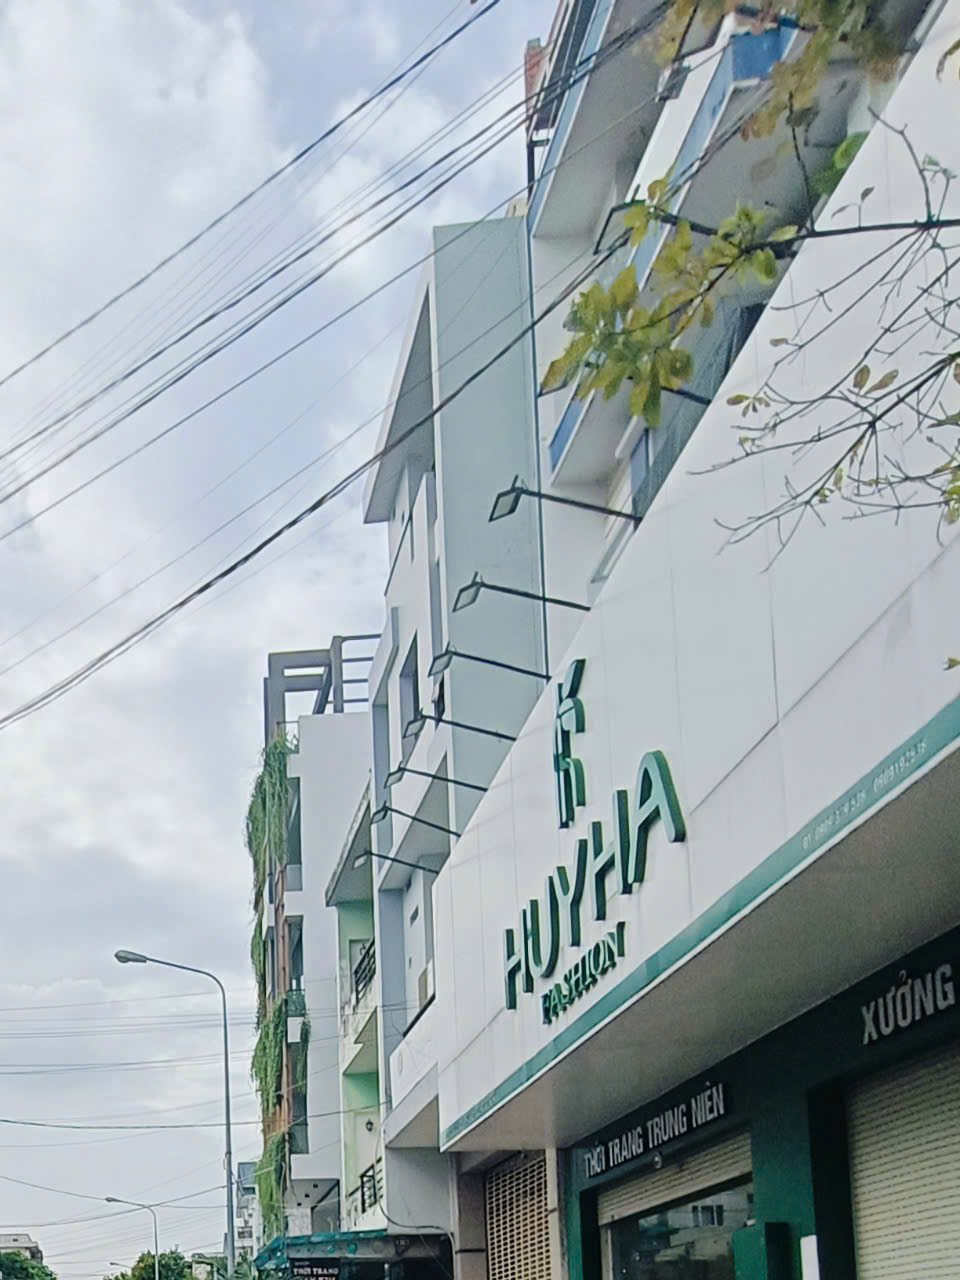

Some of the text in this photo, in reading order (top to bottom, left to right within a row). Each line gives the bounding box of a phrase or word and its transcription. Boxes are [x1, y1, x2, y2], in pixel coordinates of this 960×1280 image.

[504, 749, 686, 1010] HUYHA
[541, 921, 626, 1025] FASHION
[861, 963, 956, 1045] XƯỞNG
[607, 1125, 644, 1167] TRANG
[646, 1103, 688, 1149] TRUNG
